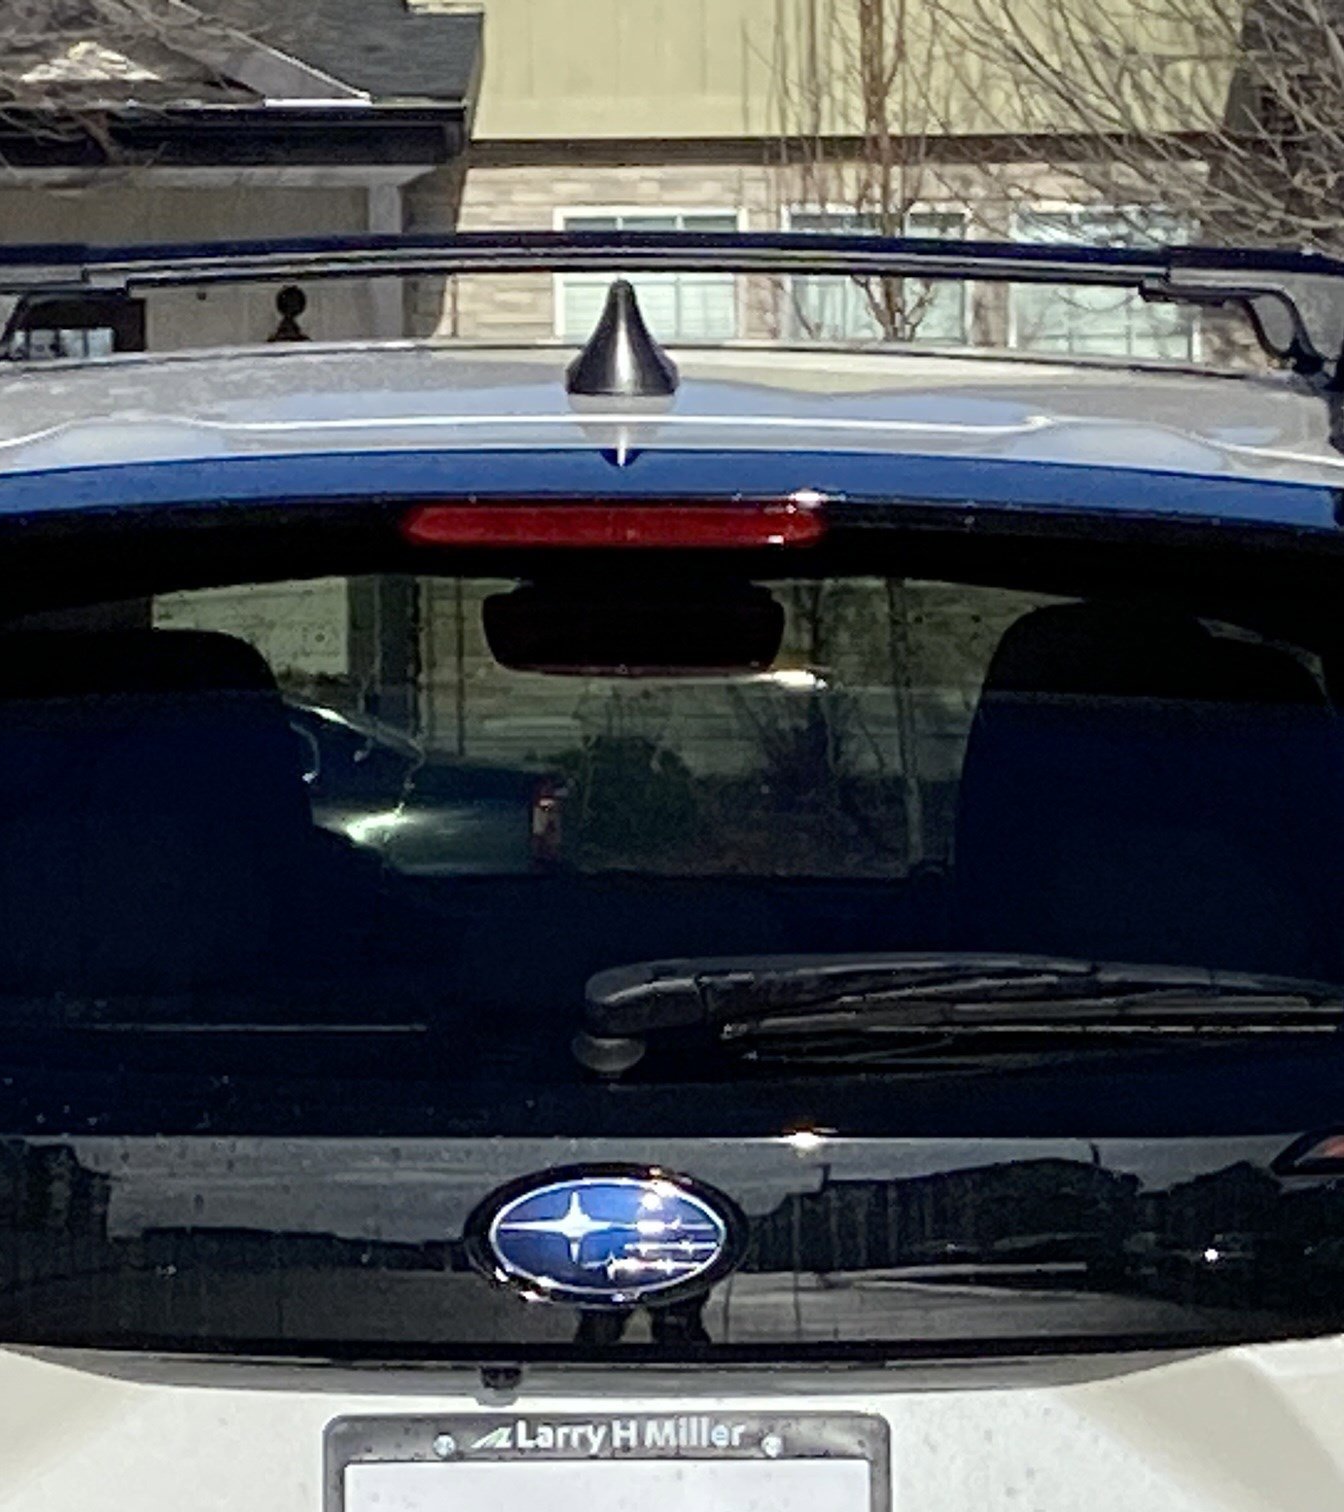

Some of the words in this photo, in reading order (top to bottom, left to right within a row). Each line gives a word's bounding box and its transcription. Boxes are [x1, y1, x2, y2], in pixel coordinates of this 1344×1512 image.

[515, 1419, 607, 1454] Larry
[612, 1420, 638, 1449] H
[644, 1416, 746, 1448] Miller
